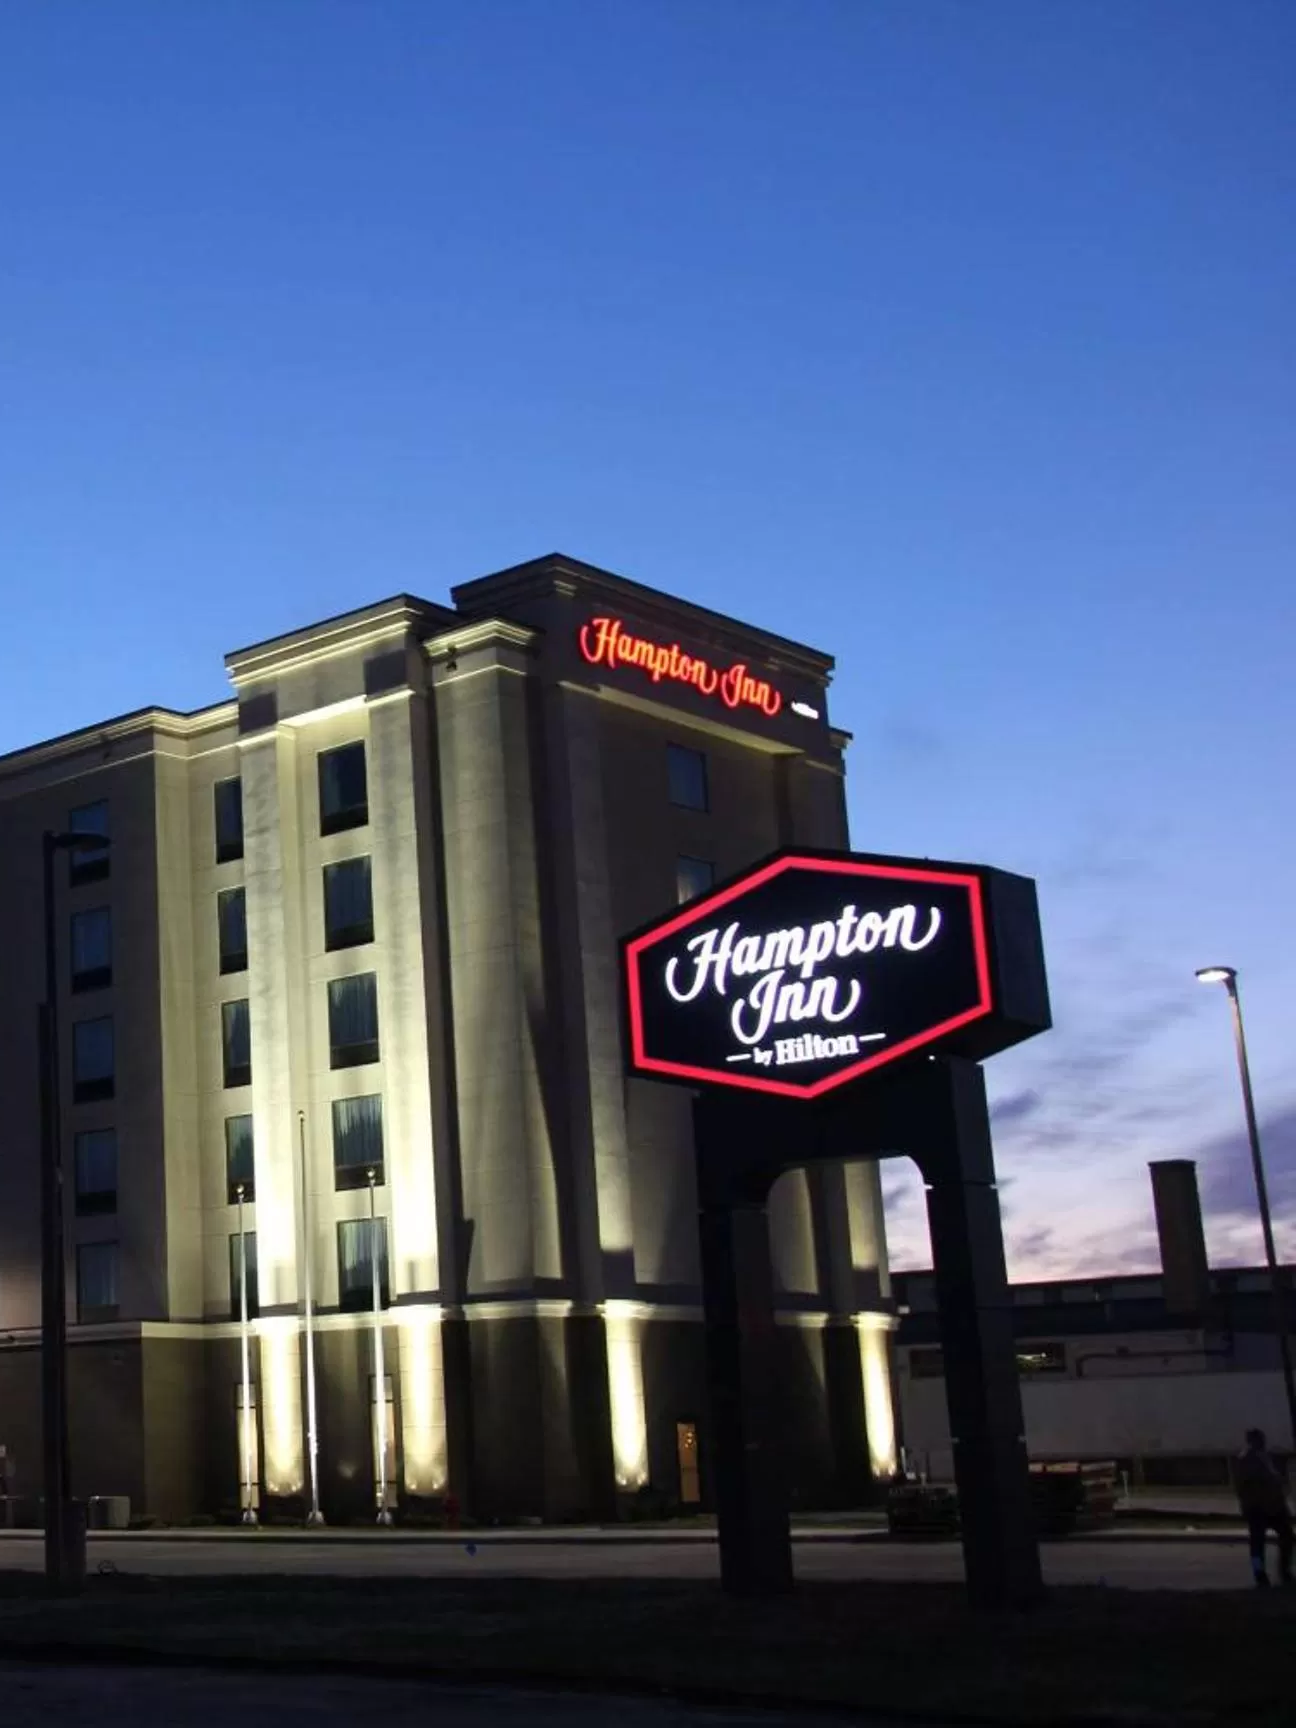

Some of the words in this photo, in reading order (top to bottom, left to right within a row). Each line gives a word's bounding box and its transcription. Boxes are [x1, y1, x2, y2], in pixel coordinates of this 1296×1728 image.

[579, 617, 719, 694] Hampton
[720, 663, 782, 716] Inn
[664, 904, 942, 1002] Hampton
[730, 969, 862, 1045] Inn
[753, 1047, 773, 1067] by
[774, 1033, 860, 1065] Hilton
